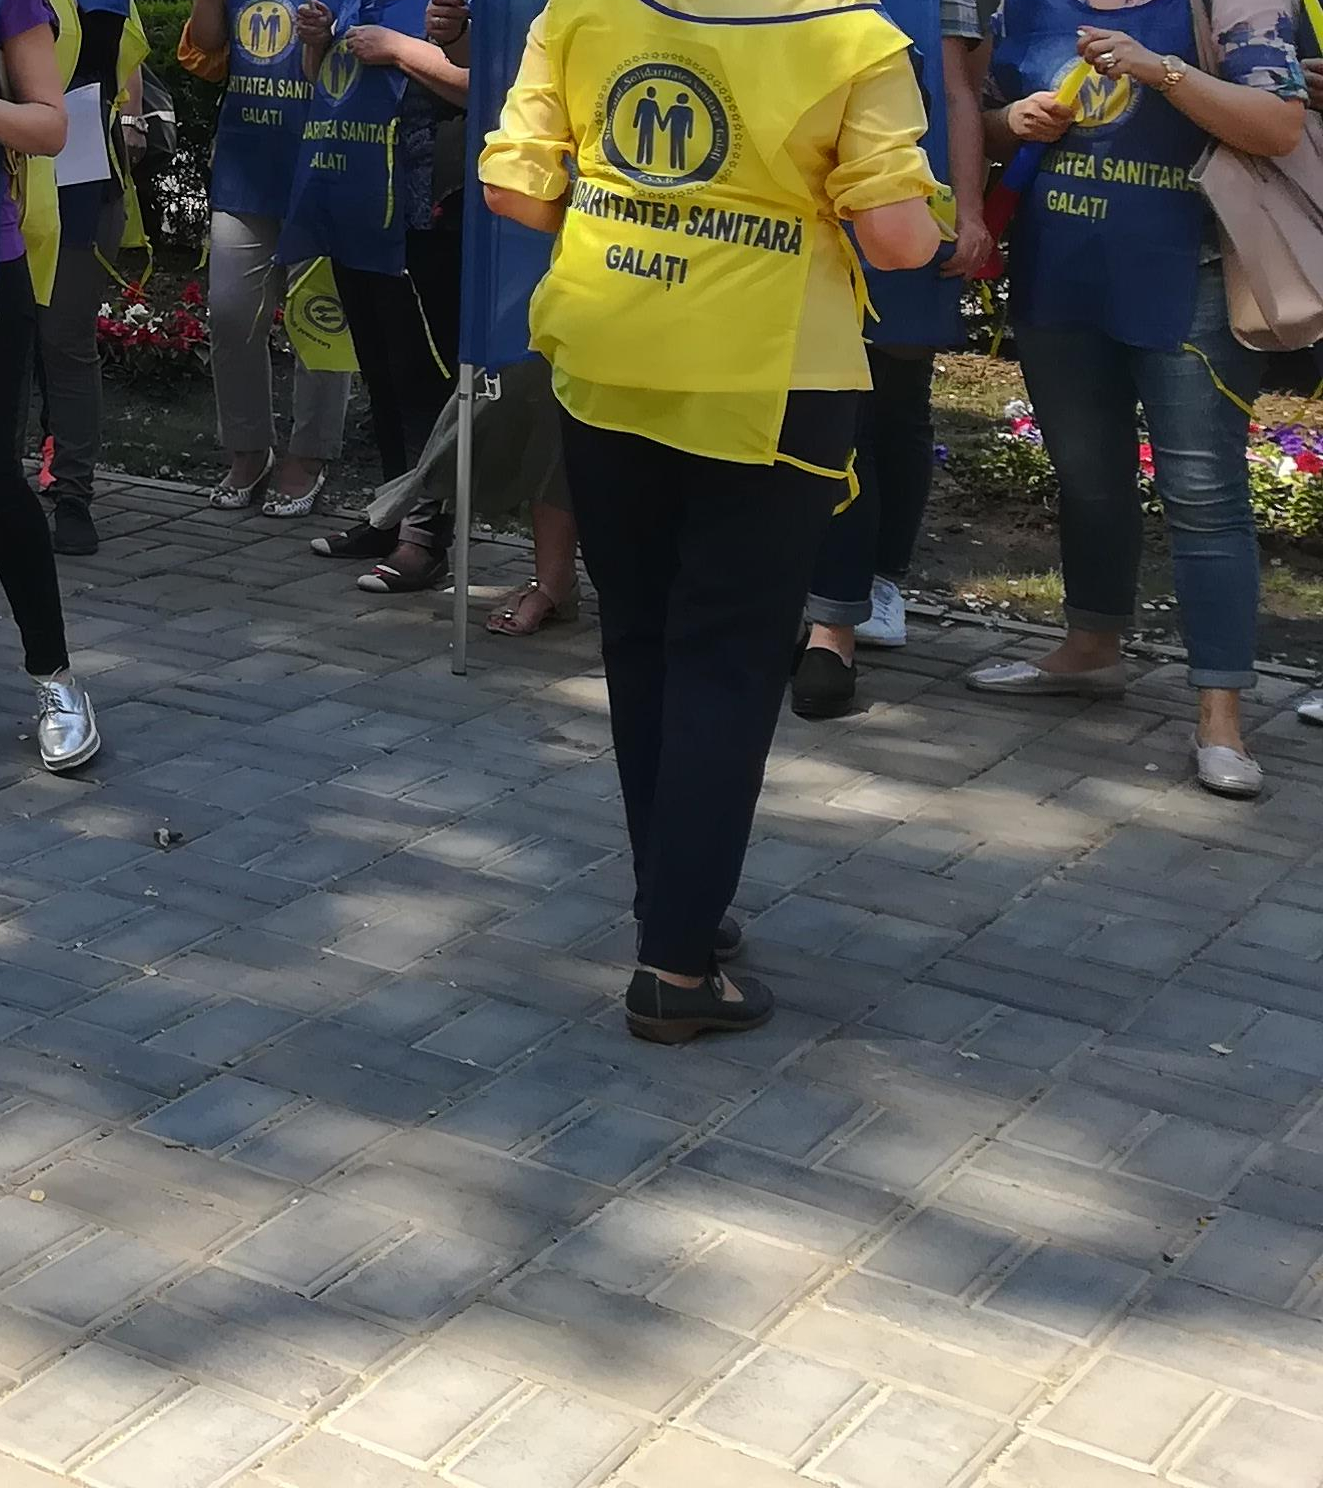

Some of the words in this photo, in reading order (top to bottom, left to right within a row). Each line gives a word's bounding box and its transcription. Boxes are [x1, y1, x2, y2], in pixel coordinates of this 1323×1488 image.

[684, 205, 804, 256] SANITARĂ
[1047, 190, 1108, 224] GALAȚI
[606, 244, 689, 292] GALAȚI
